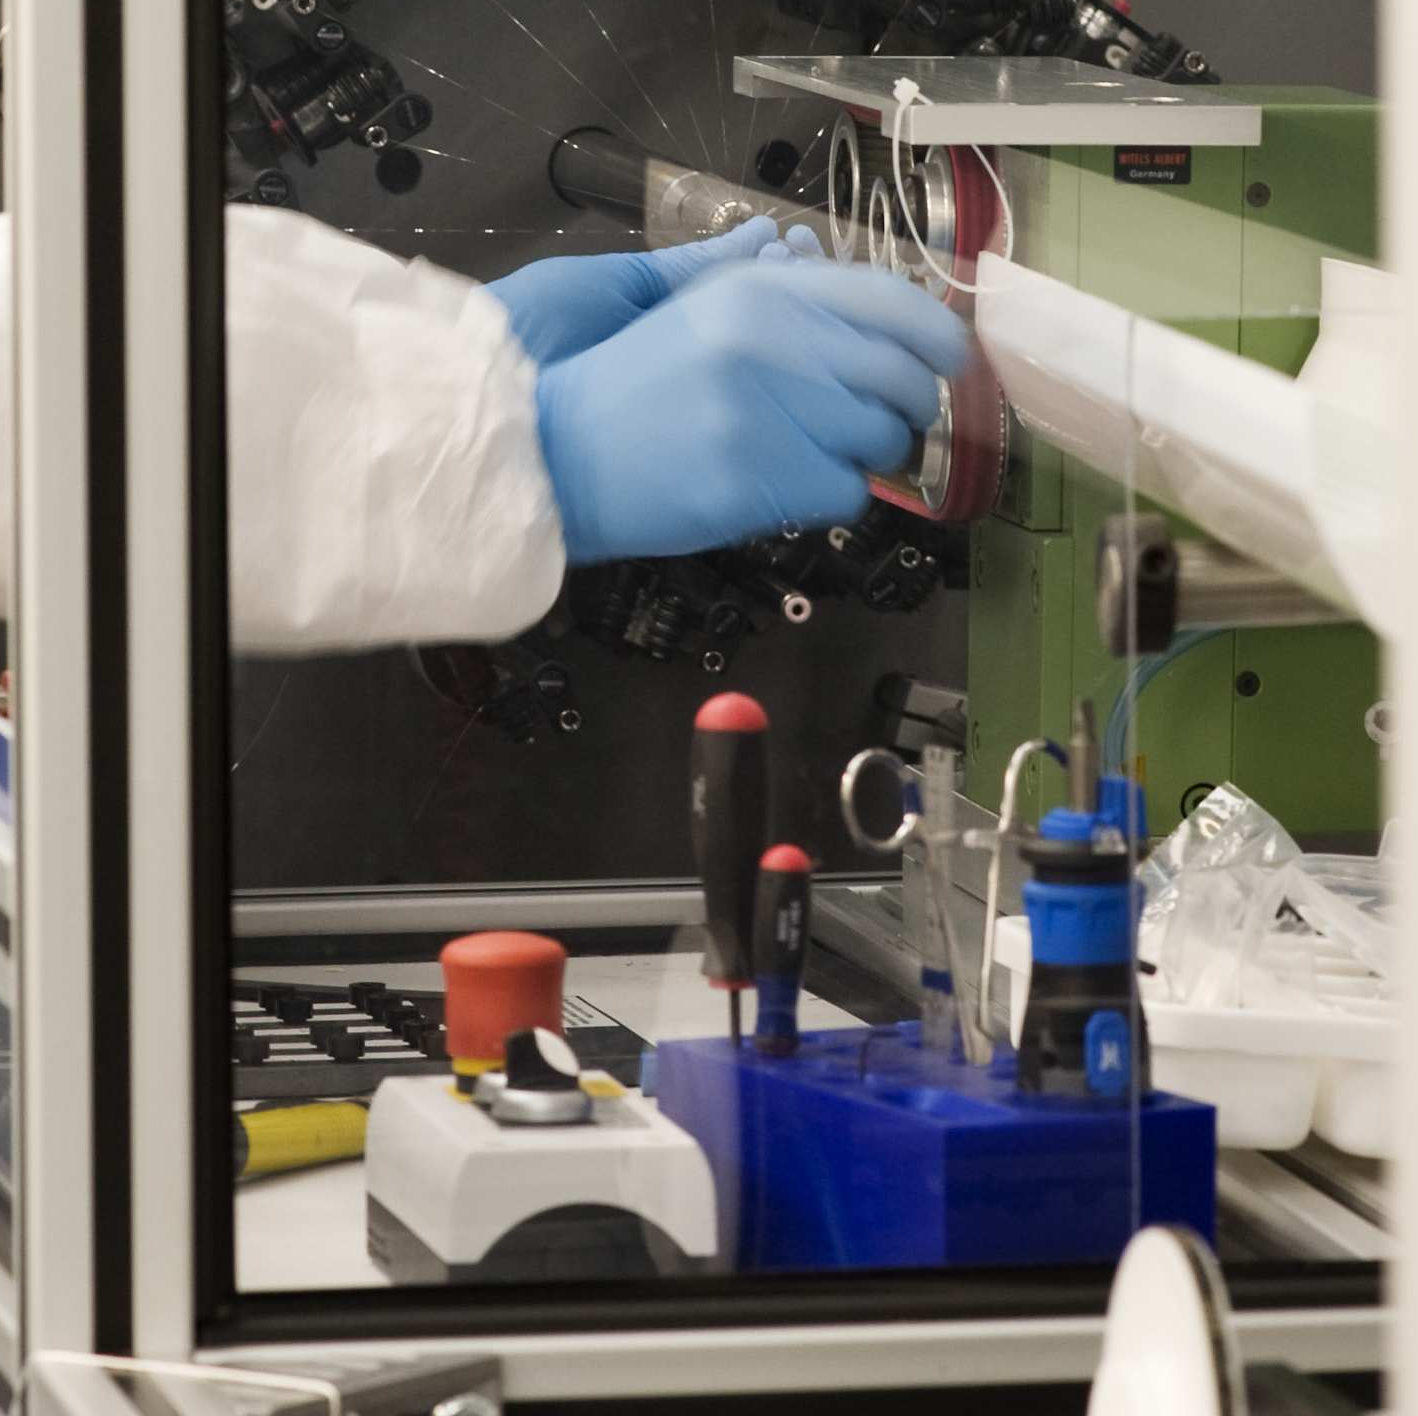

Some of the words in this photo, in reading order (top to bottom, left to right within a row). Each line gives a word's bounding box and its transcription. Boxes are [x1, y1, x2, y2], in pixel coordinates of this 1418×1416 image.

[1118, 152, 1151, 165] WITELS
[1153, 152, 1187, 165] ALBERT
[1129, 169, 1176, 180] Germany
